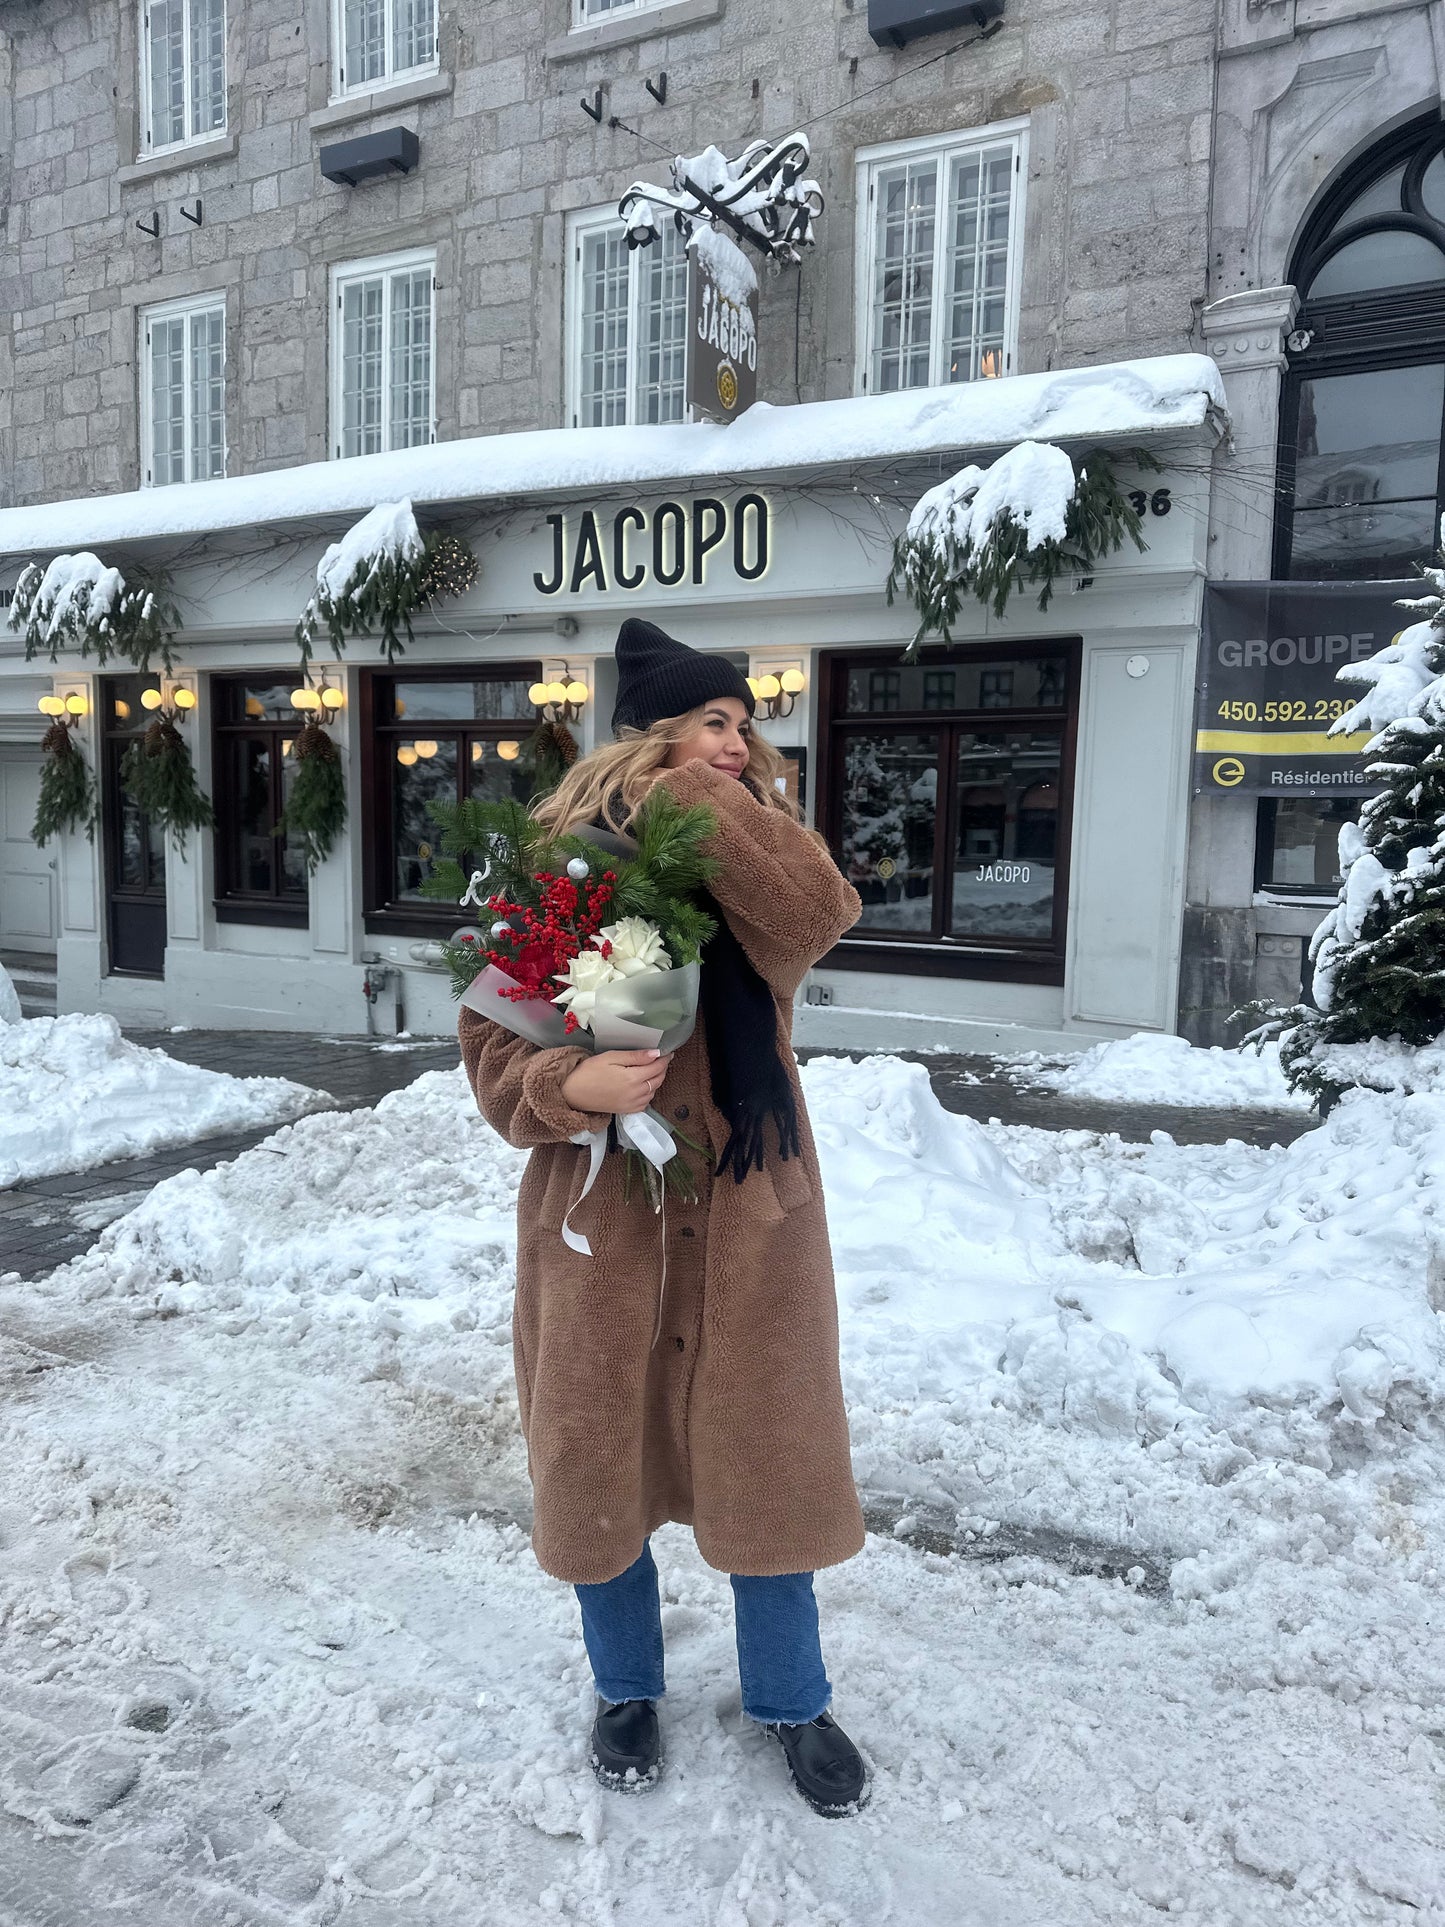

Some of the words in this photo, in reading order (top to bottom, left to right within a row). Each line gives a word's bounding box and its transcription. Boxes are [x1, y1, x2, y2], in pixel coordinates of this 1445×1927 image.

[697, 284, 757, 372] JACOPO
[533, 493, 768, 595] JACOPO
[1217, 632, 1375, 668] GROUPE
[975, 864, 1031, 883] JACOPO
